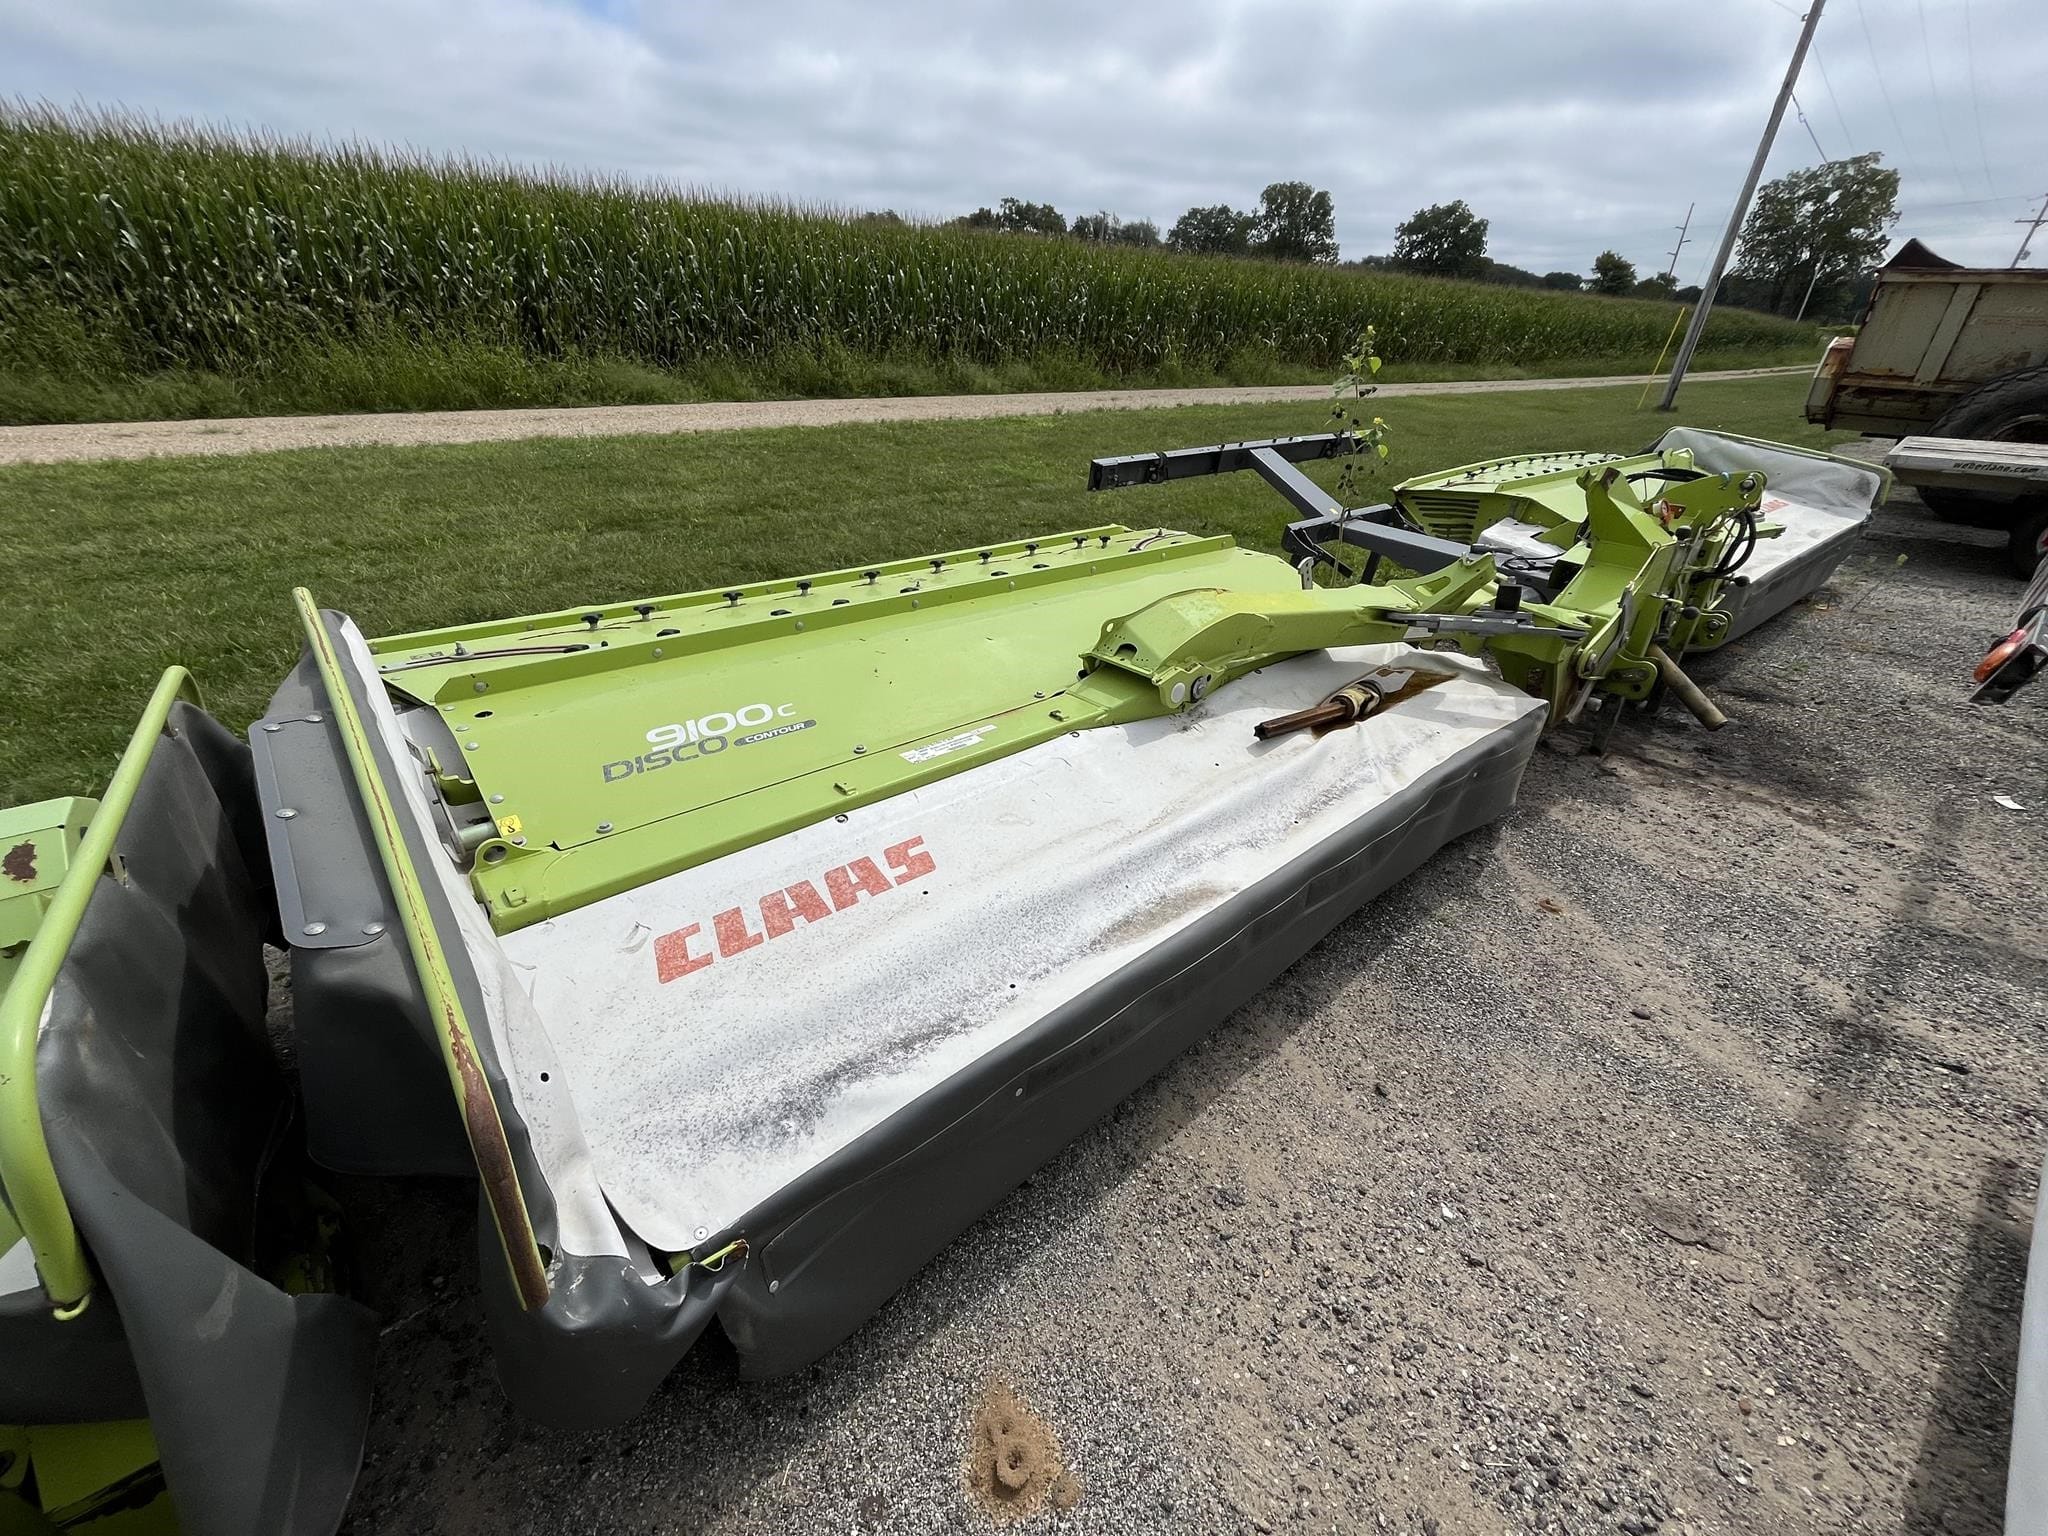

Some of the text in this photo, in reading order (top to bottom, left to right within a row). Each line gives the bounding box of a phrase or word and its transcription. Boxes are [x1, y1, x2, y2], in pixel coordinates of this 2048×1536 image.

[602, 722, 806, 784] DISCO CONTOUR
[646, 703, 774, 752] 9100
[653, 835, 937, 985] CLAAS
